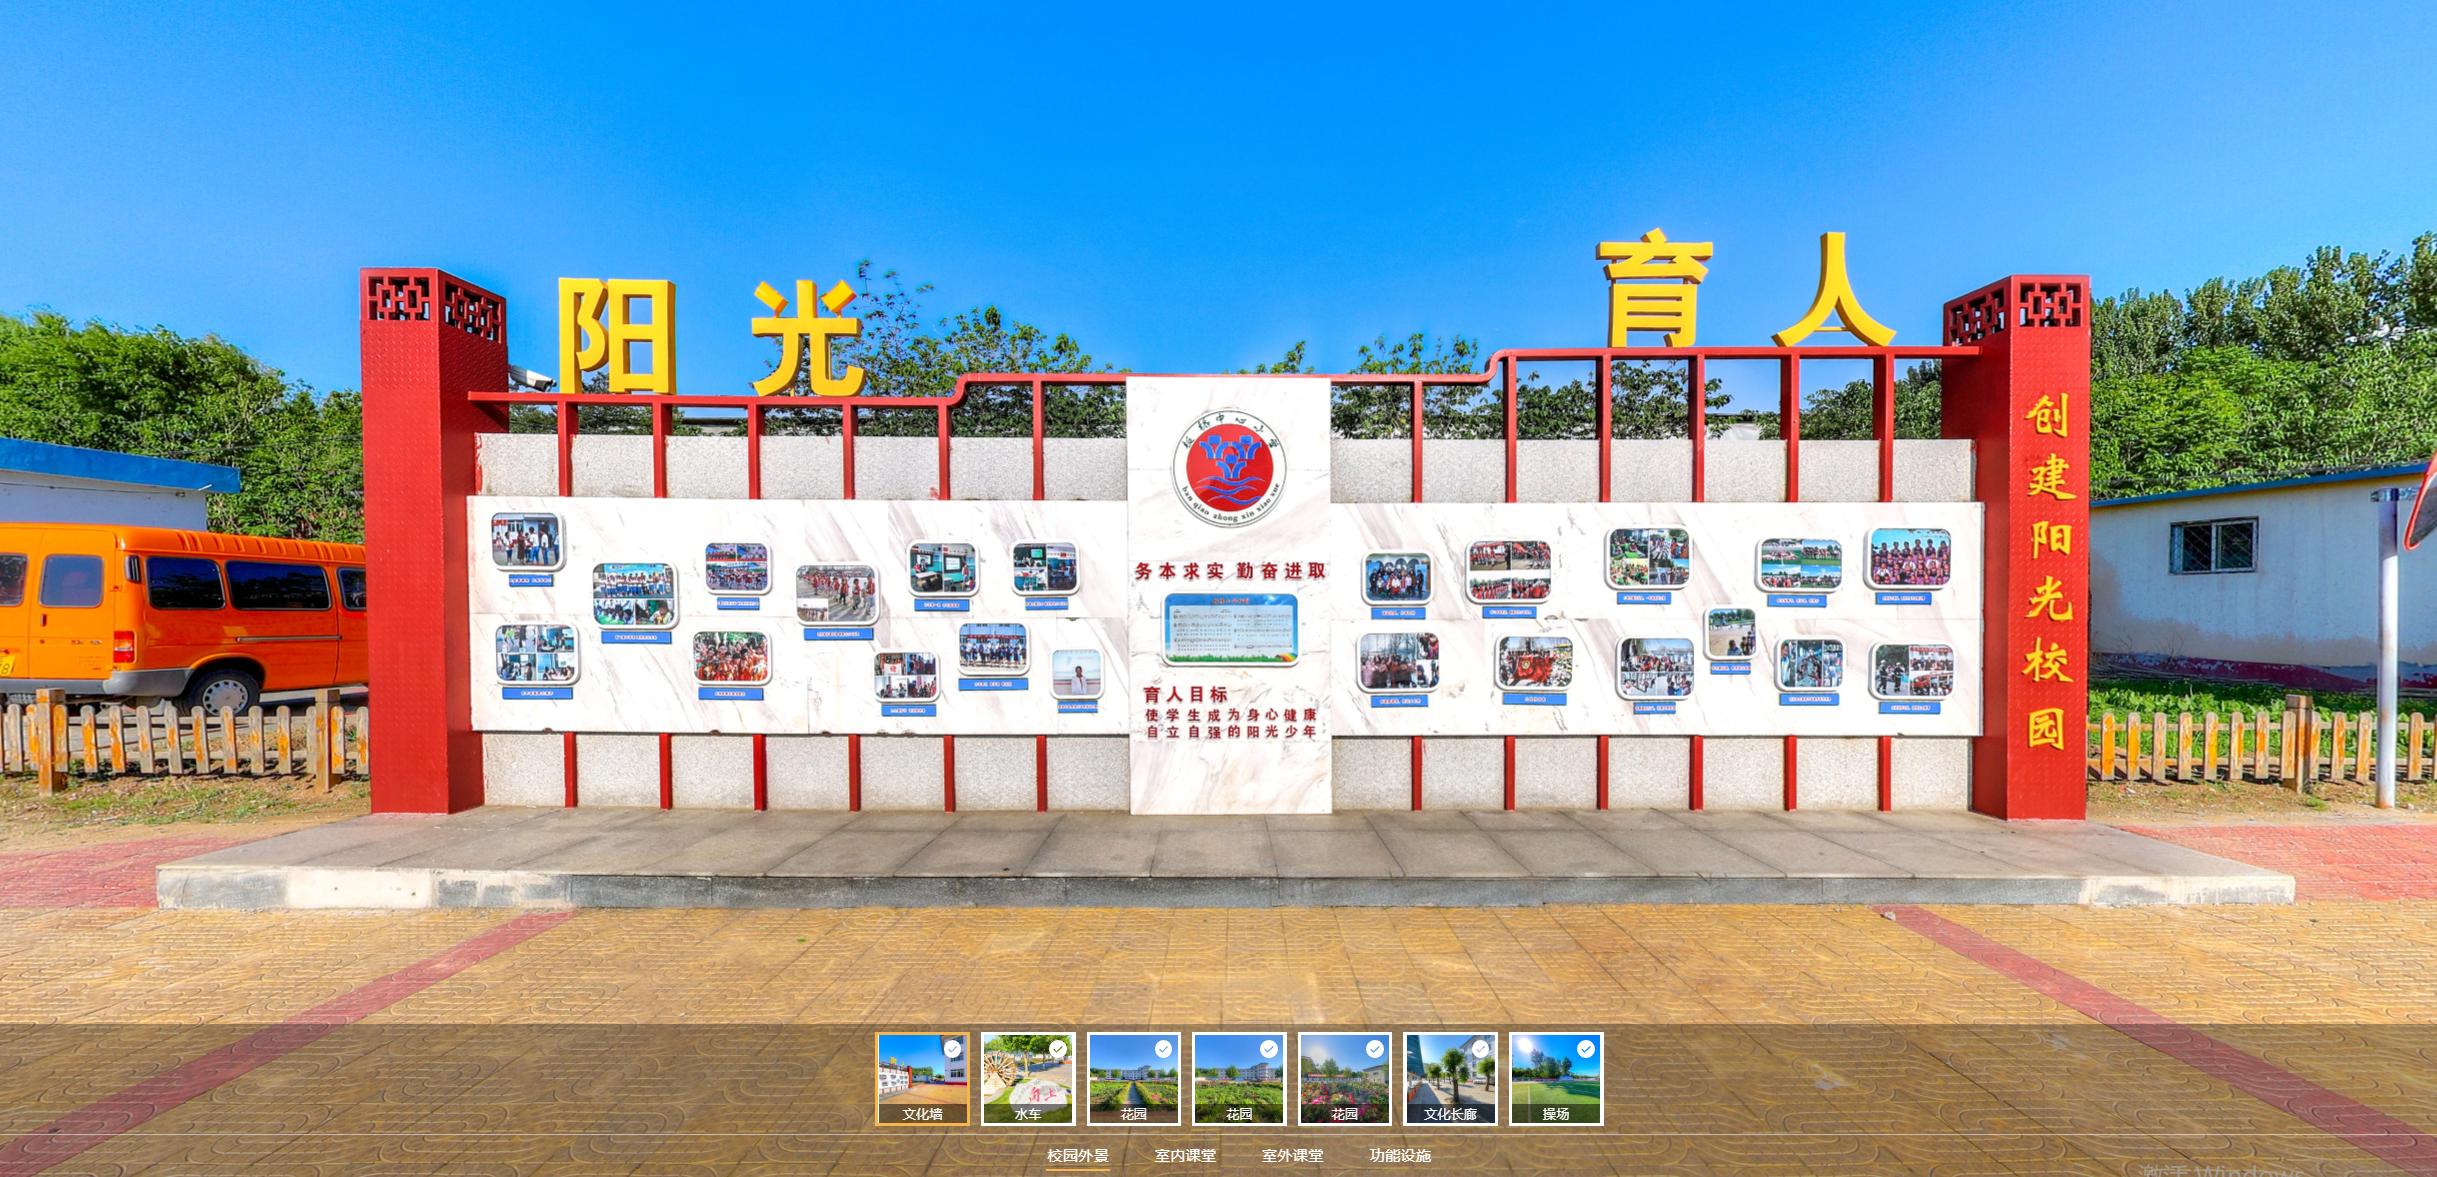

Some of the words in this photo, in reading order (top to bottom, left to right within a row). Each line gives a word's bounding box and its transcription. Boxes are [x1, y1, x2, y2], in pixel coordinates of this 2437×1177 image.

[1596, 231, 1896, 347] 育人
[558, 277, 865, 397] 阳光
[1135, 562, 1224, 579] 务本求实
[1236, 562, 1326, 579] 勤奋进取
[2024, 392, 2076, 751] 创建阳光校园
[1144, 686, 1228, 703] 育人目标
[1145, 708, 1317, 722] 使学生成为身心健康
[1147, 725, 1317, 739] 自立自强的阳光少年
